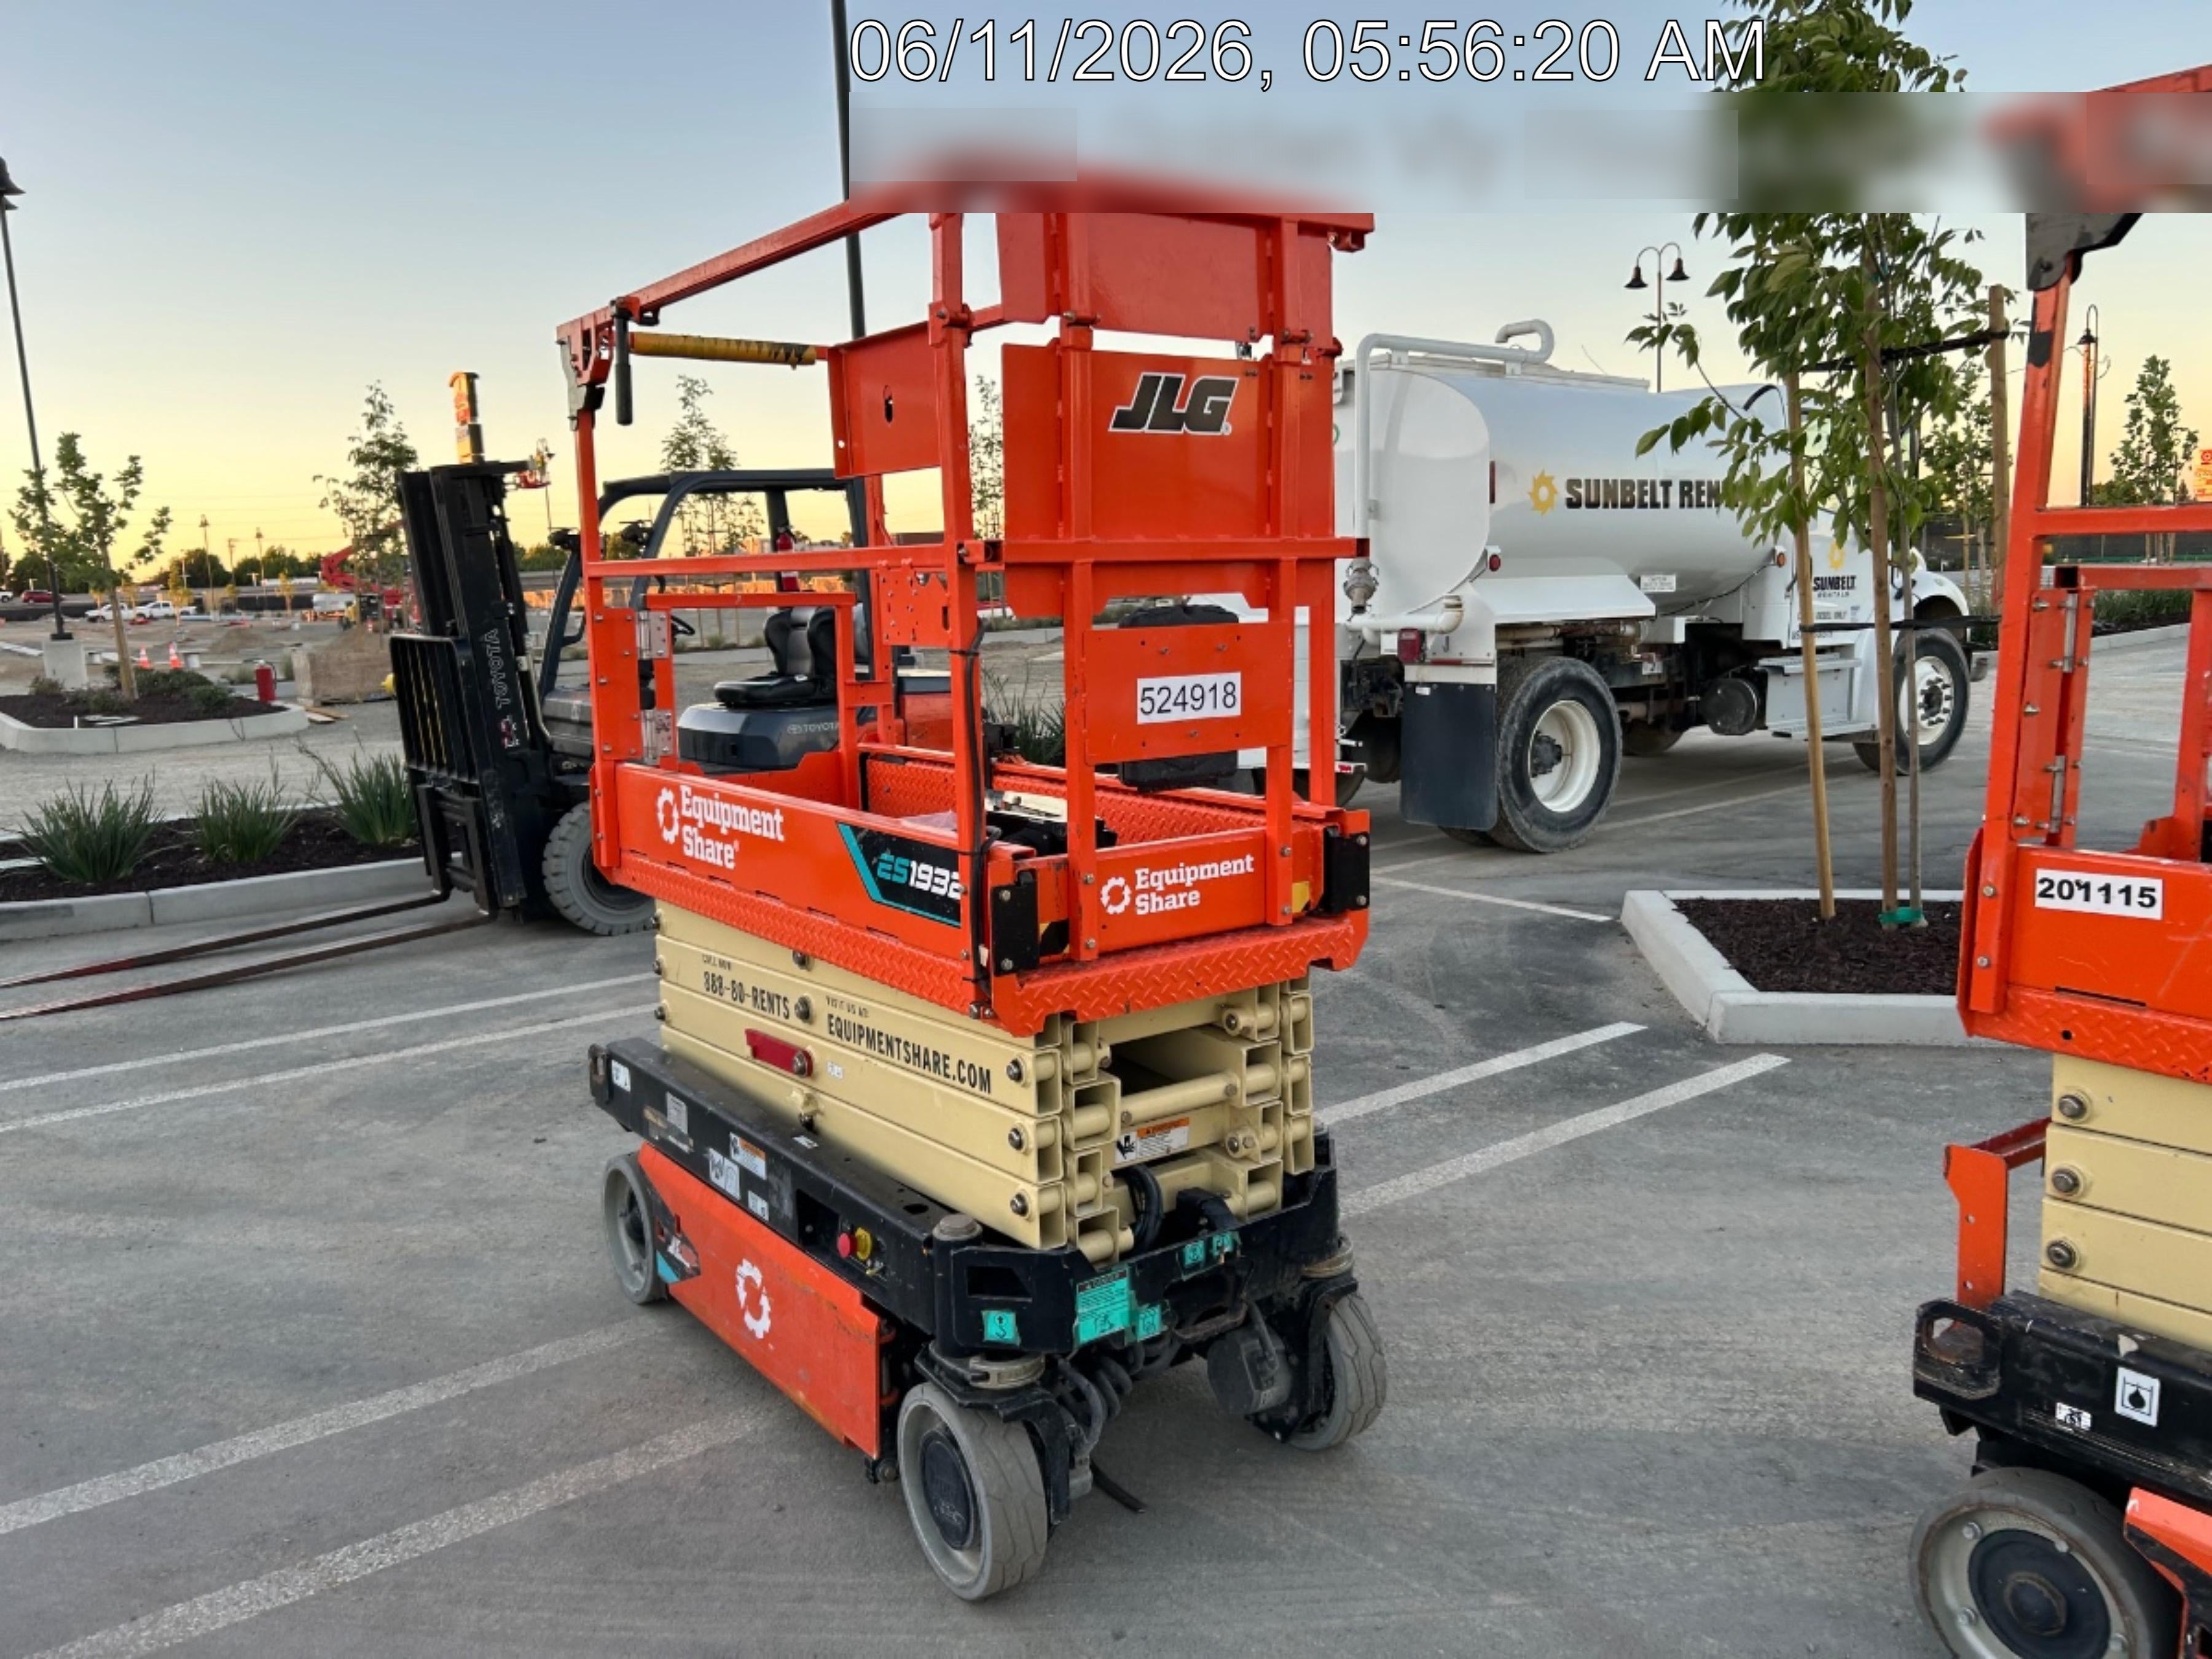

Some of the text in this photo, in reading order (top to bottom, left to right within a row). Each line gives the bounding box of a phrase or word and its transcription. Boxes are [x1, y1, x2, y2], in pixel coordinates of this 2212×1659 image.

[1108, 372, 1239, 435] JLG
[1565, 479, 1672, 509] SUNBELT
[1813, 575, 1857, 591] SUNBELT
[484, 629, 511, 710] TOYOTA
[1140, 681, 1236, 715] 524918
[680, 784, 785, 842] Equipment
[681, 825, 735, 869] Share
[1135, 853, 1254, 891] Equipment
[1135, 890, 1200, 915] Share
[2037, 877, 2156, 908] 201115
[827, 1013, 991, 1094] EQUIPMENTSHARE.COM
